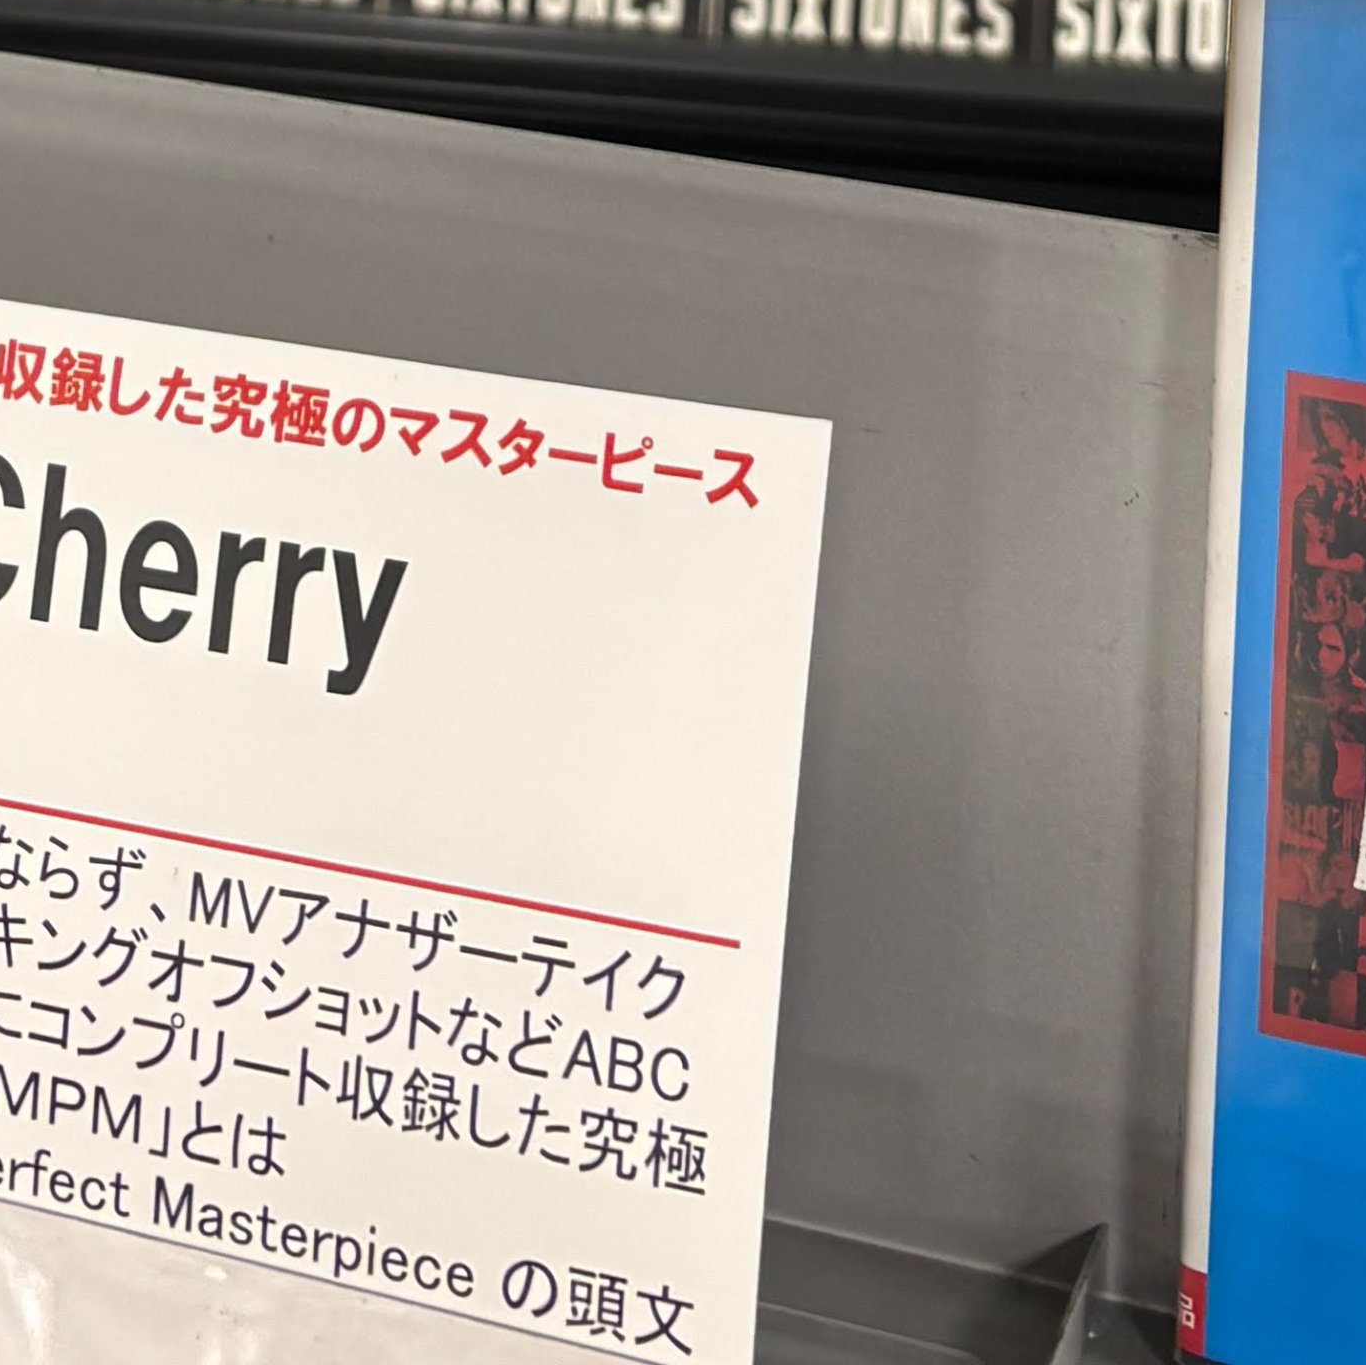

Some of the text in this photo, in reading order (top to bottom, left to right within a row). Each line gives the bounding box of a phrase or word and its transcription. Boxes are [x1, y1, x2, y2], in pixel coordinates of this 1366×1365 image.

[153, 1176, 475, 1299] Masterpiece
[501, 1259, 695, 1356] の頭文
